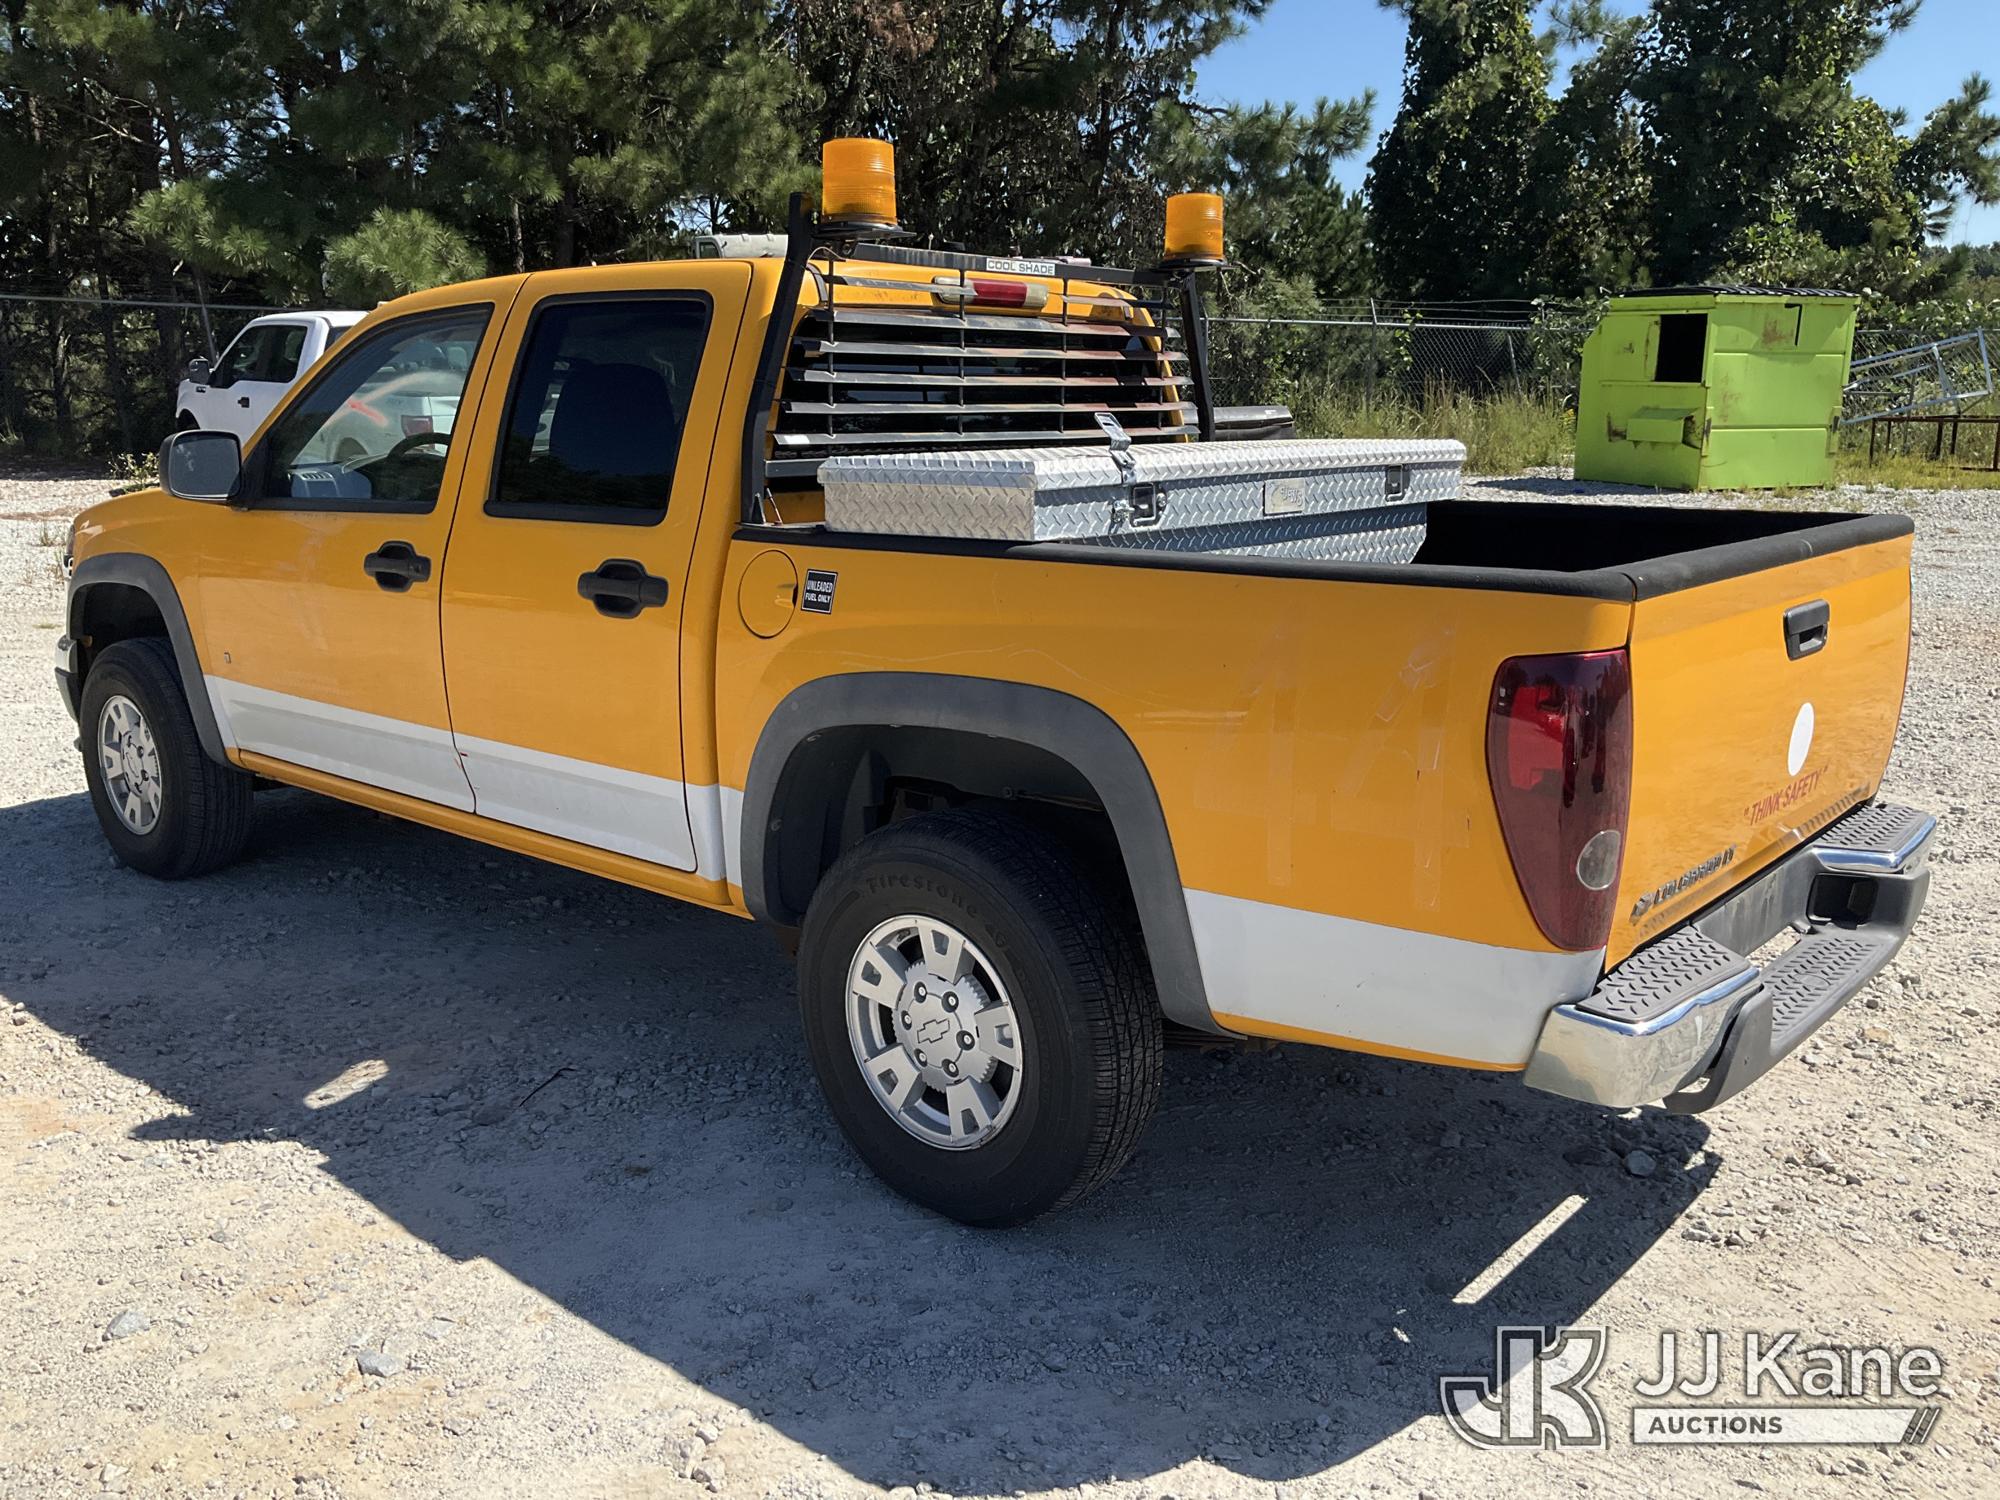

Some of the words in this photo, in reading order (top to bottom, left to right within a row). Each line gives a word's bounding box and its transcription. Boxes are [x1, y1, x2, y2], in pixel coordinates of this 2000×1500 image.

[988, 260, 1016, 271] COOL
[1018, 263, 1054, 275] SHADE
[807, 580, 833, 592] UNLEADED
[805, 592, 816, 602] FUEL
[818, 594, 831, 603] ONLY
[866, 873, 978, 919] Firestone
